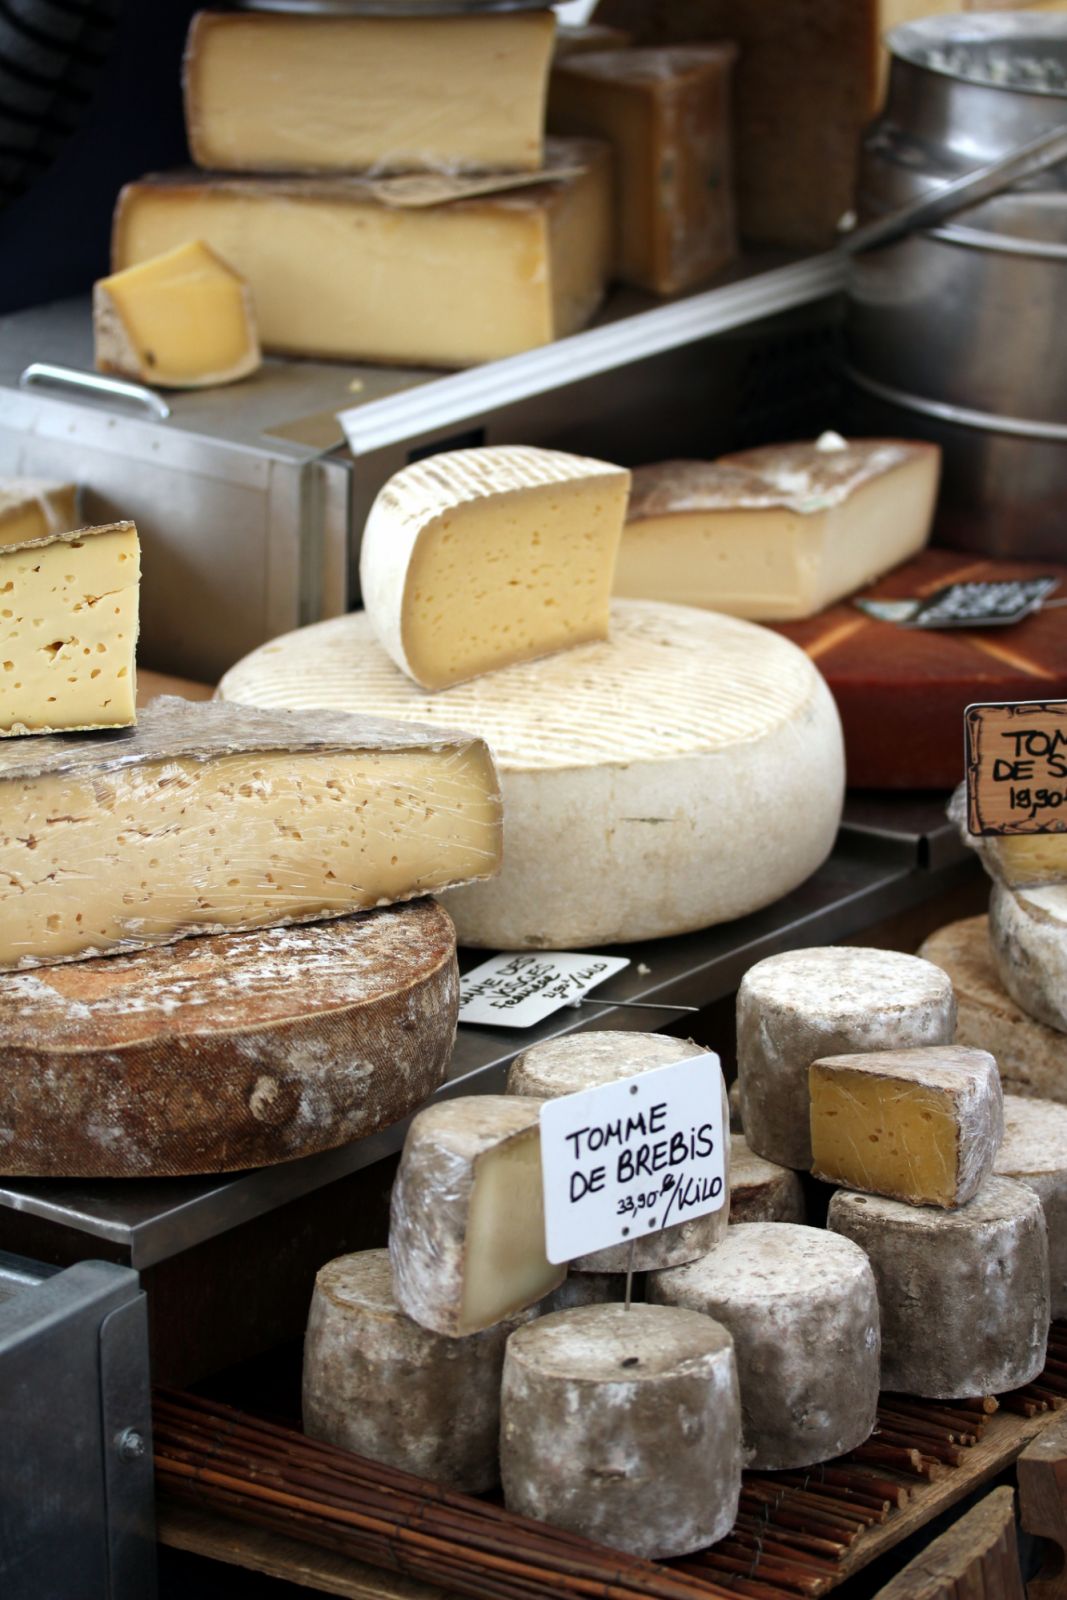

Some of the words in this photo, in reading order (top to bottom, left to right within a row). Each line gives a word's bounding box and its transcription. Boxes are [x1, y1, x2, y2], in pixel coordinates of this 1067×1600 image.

[993, 758, 1035, 782] DE
[1009, 786, 1067, 818] 19,90
[459, 978, 504, 1009] OMME
[496, 956, 536, 976] DES
[486, 963, 555, 999] VOSGES
[565, 1102, 667, 1160] TOMME
[570, 1166, 606, 1203] DE
